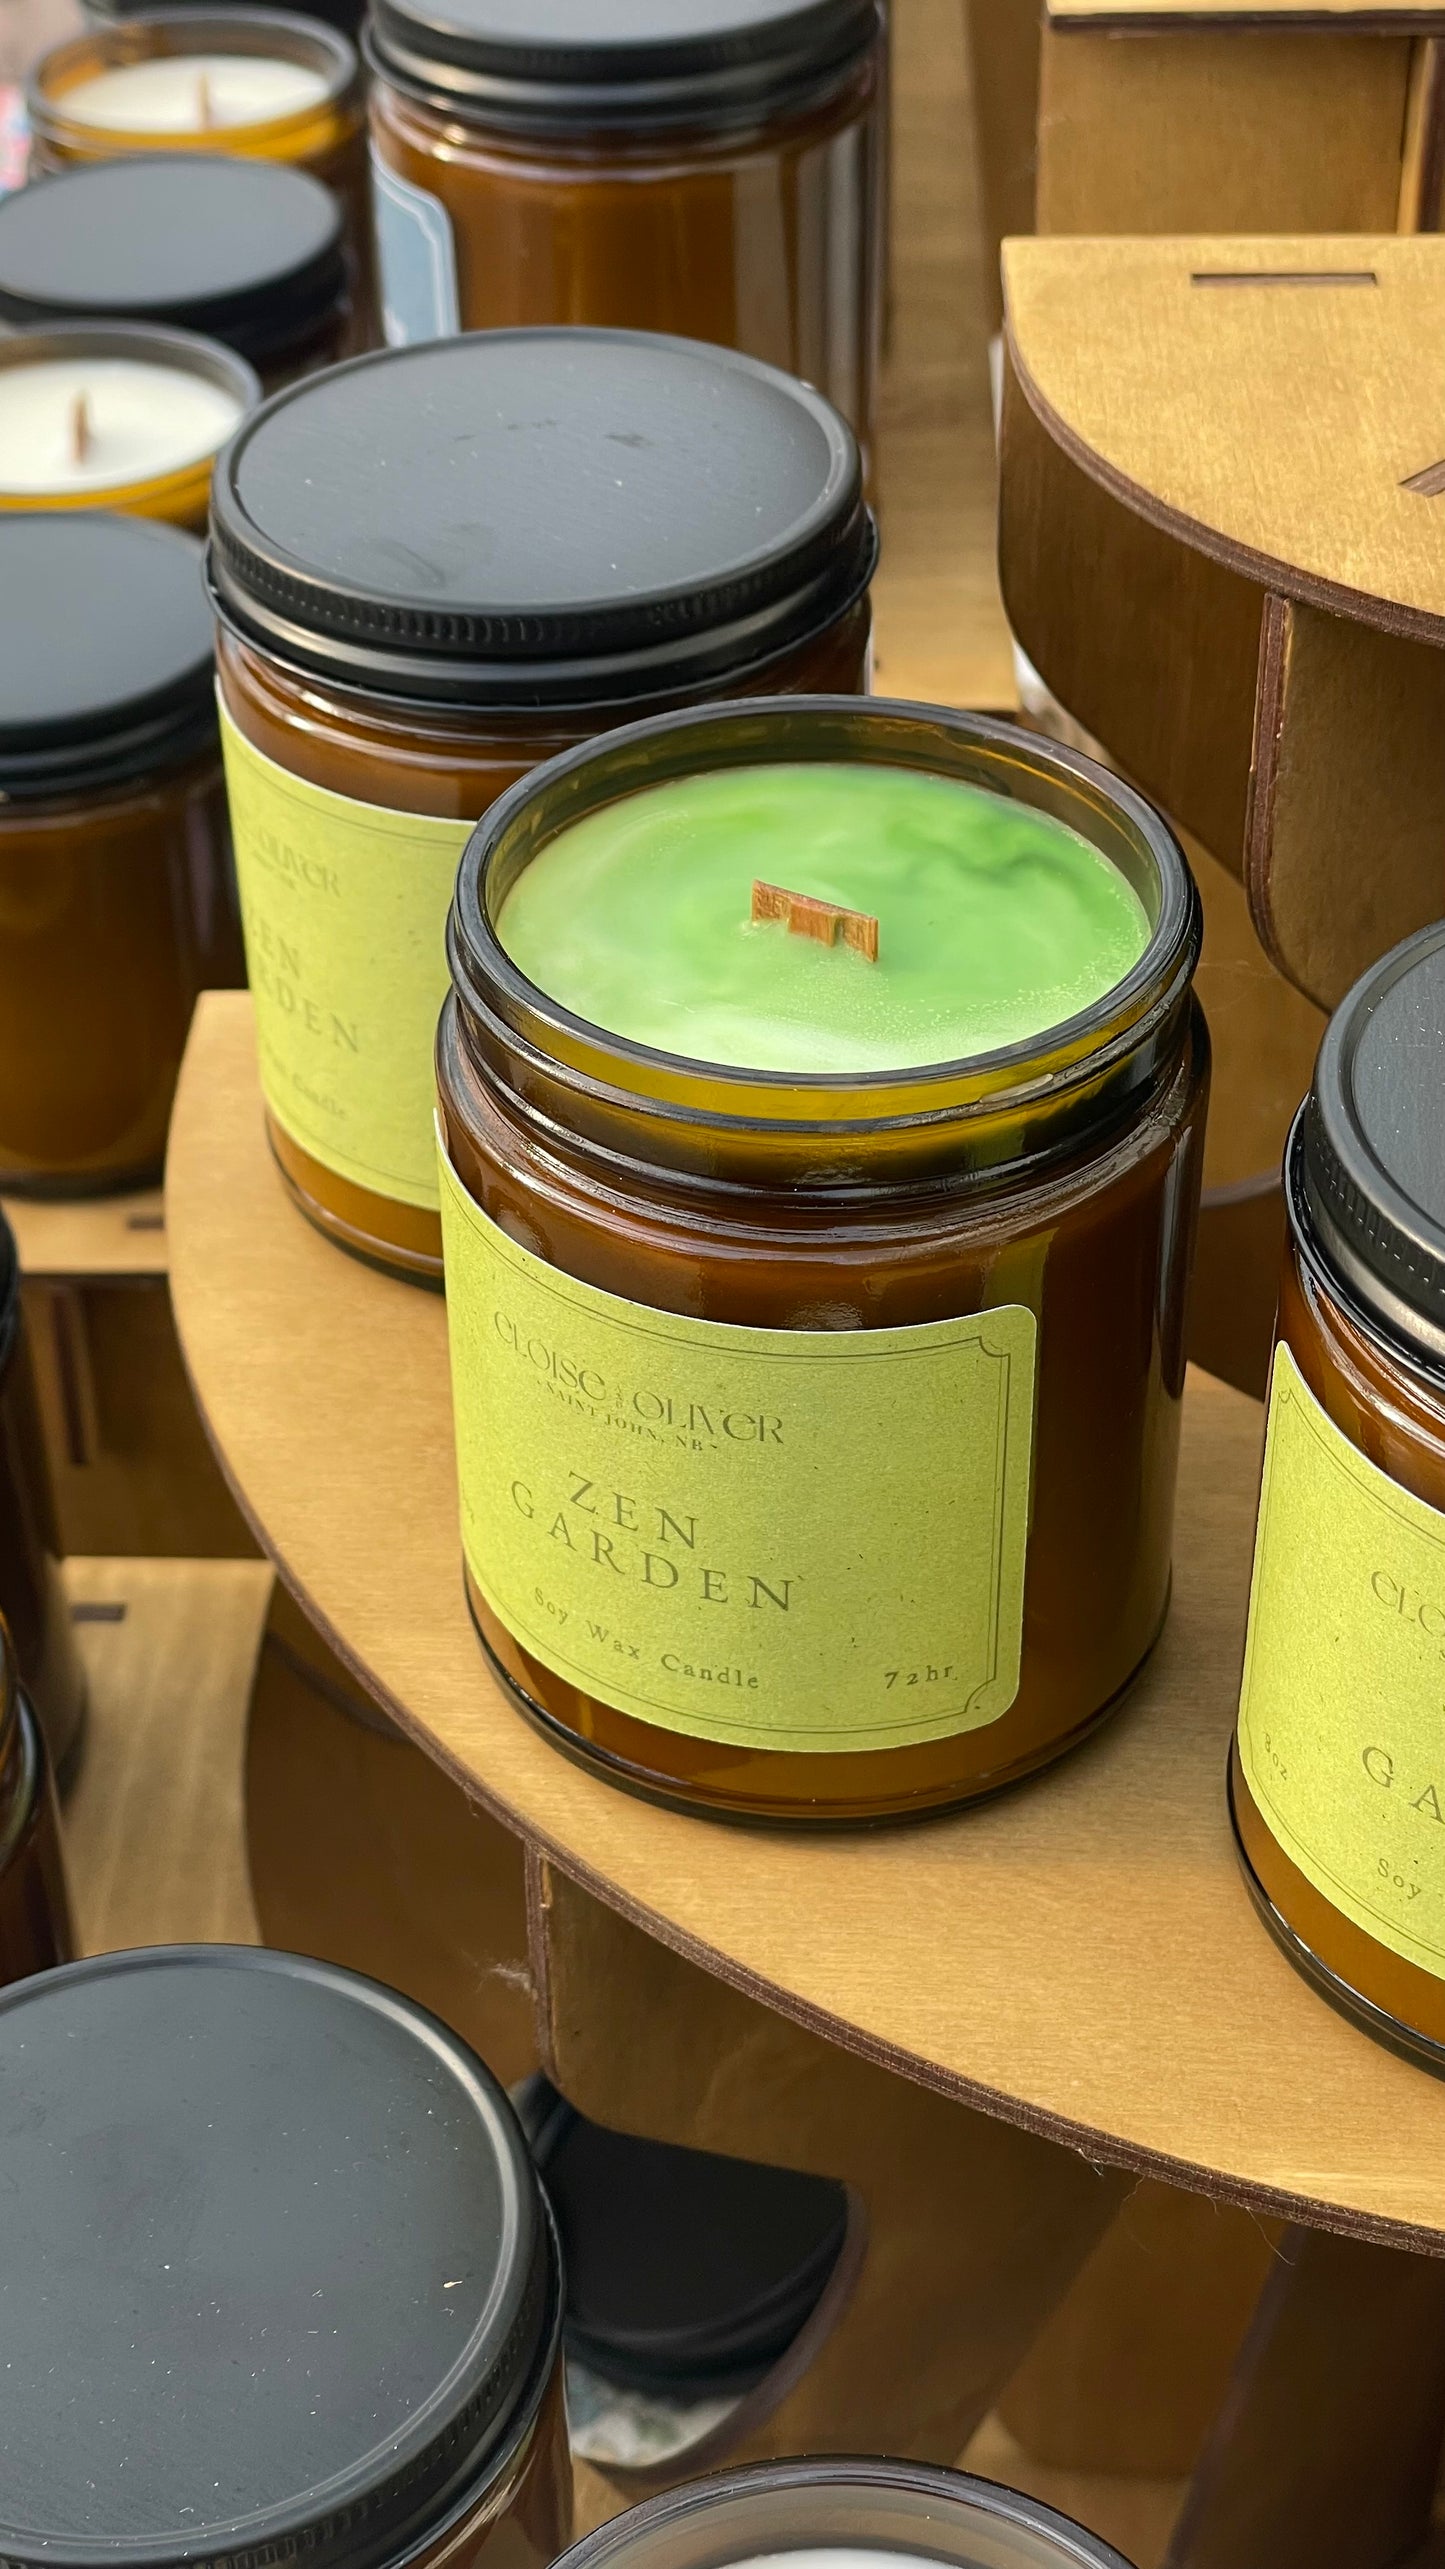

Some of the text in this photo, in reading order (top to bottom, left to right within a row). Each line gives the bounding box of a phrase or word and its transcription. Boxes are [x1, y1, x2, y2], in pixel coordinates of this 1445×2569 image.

[511, 1481, 794, 1612] GARDEN
[568, 1470, 699, 1550] ZEN
[534, 1586, 760, 1690] Soy Wax Candle
[1377, 1857, 1423, 1901] Soy
